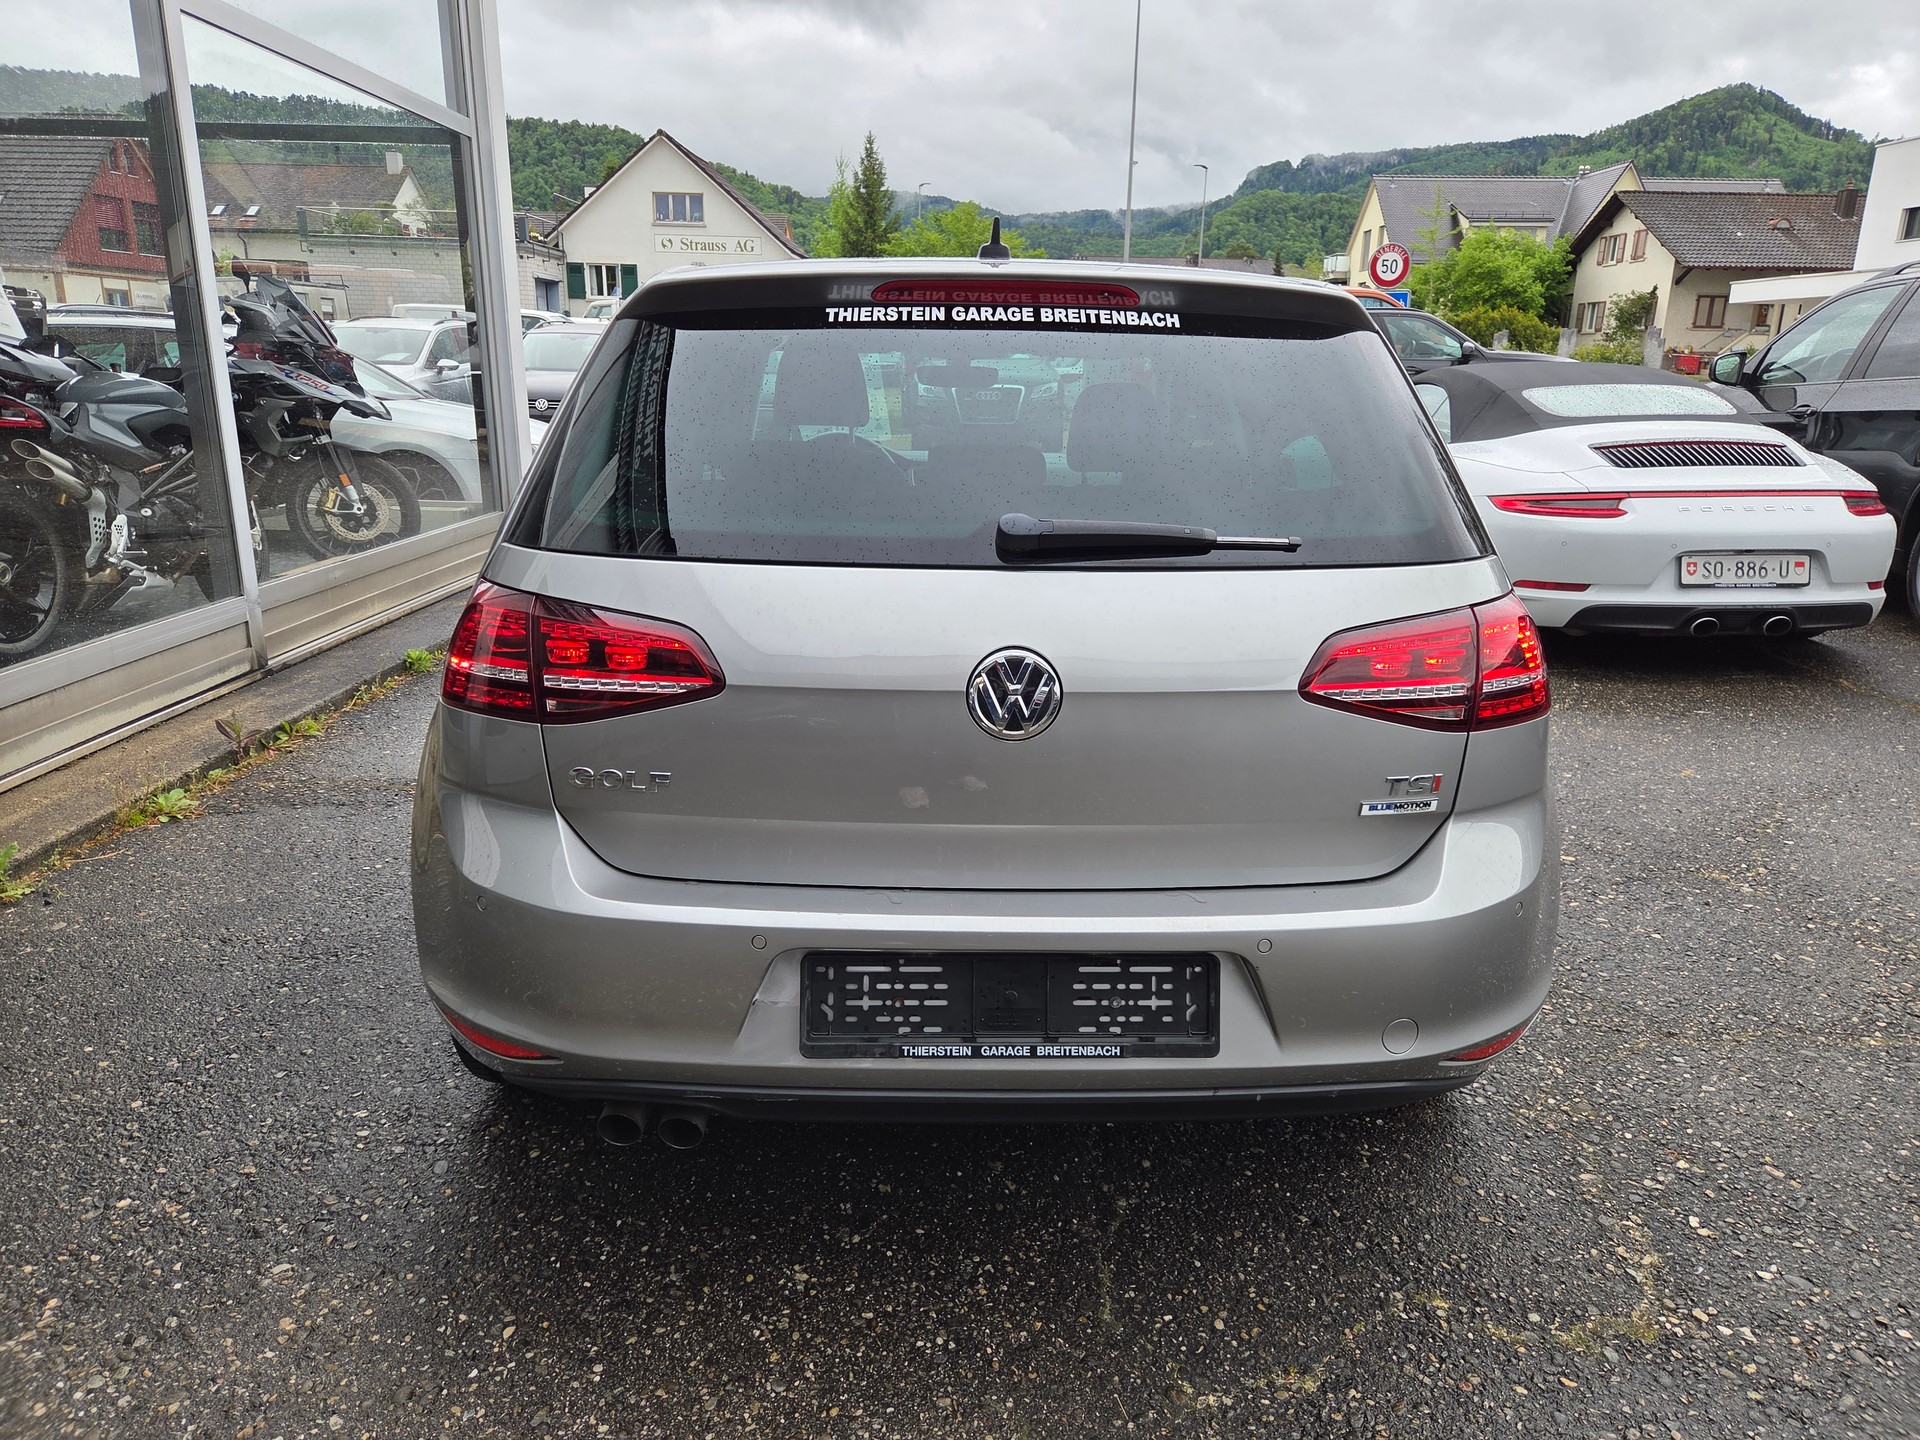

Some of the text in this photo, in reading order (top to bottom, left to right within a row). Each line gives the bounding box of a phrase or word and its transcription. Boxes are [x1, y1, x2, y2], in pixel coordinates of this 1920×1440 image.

[680, 237, 755, 252] Strauss AG
[1375, 245, 1408, 260] GENERELL
[1381, 259, 1398, 274] 50
[826, 306, 1181, 328] THIERSTEIN GARAGE BREITENBACH
[1678, 504, 1815, 513] PORSCHE
[568, 766, 672, 793] GOLF
[1385, 773, 1443, 796] TSI
[1368, 801, 1432, 812] BLUEMOTION
[902, 1045, 1121, 1057] THIERSTEIN GARAGE BREITENBACH
